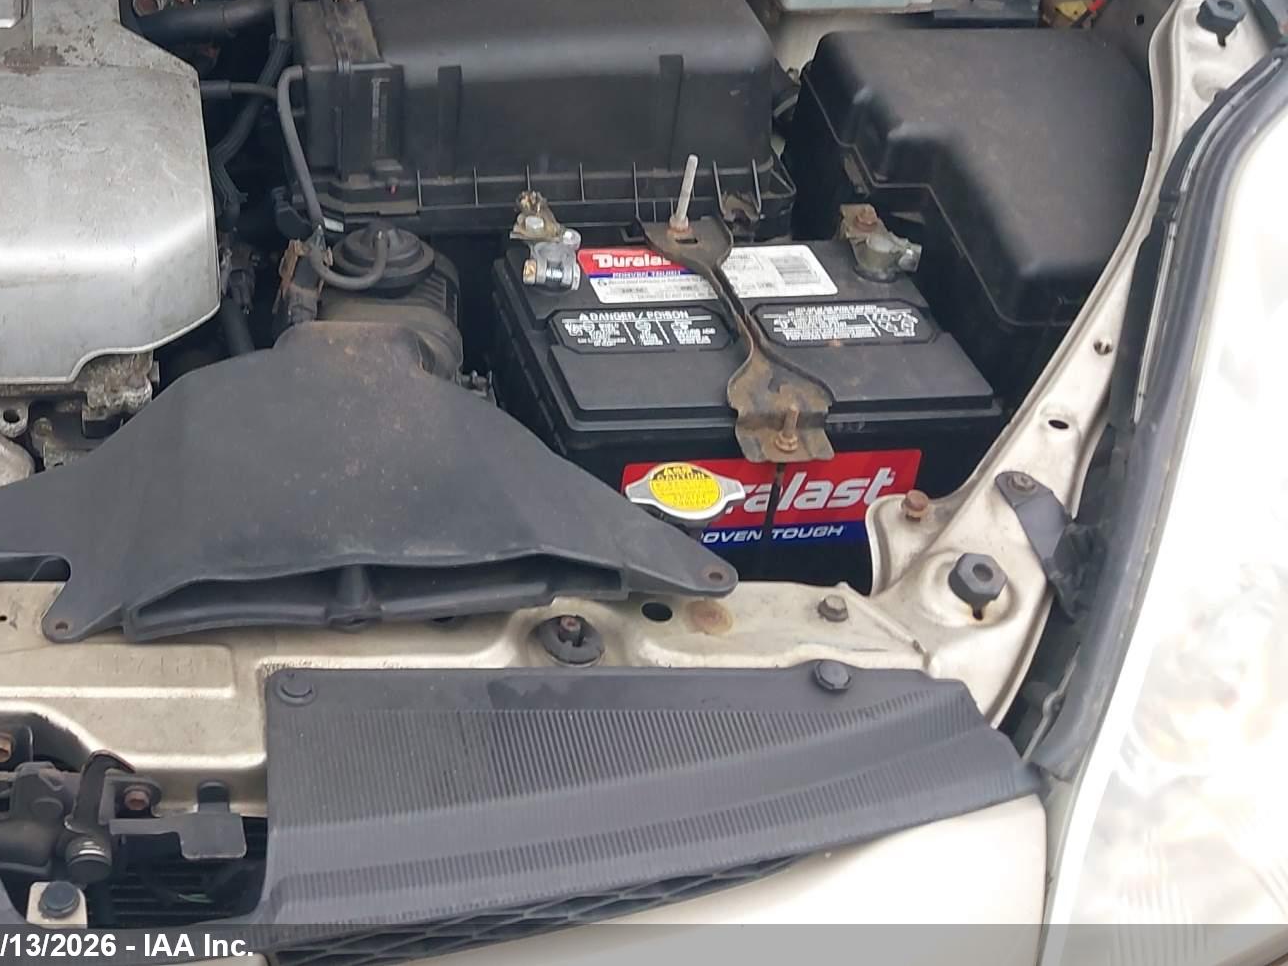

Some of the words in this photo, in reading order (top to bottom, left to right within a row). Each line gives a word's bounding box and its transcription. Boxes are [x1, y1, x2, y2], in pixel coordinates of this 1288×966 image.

[592, 253, 673, 269] Durala
[725, 467, 895, 514] ralast
[700, 530, 763, 544] OVEN
[771, 525, 844, 540] TOUGH
